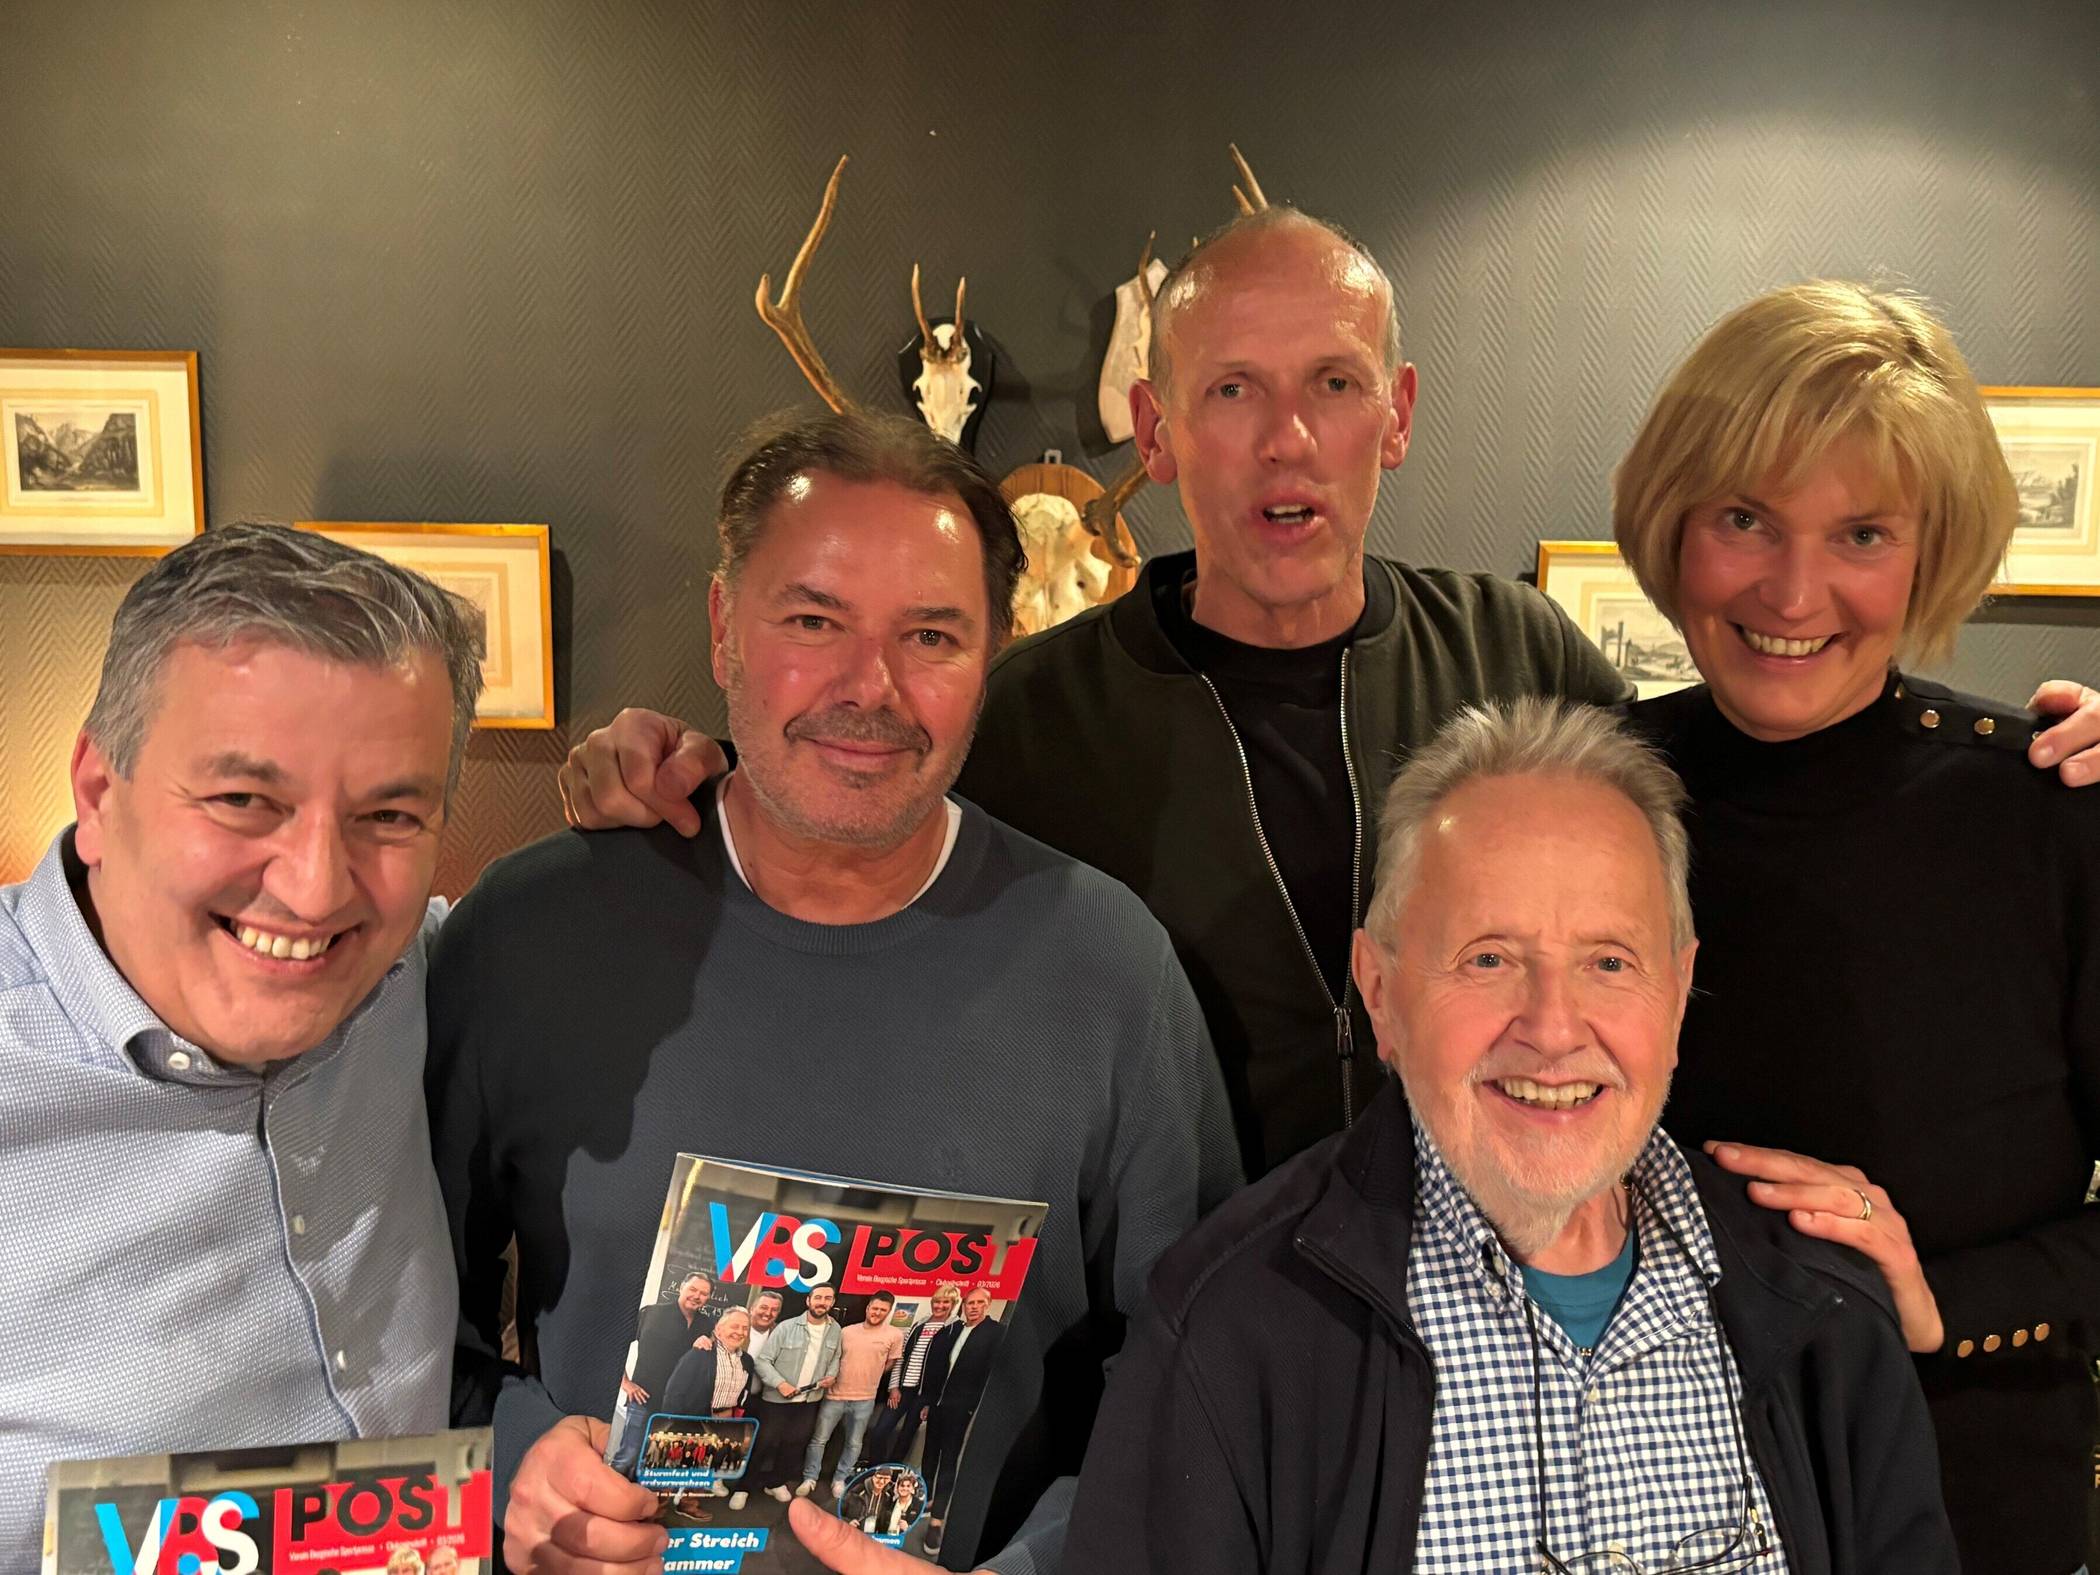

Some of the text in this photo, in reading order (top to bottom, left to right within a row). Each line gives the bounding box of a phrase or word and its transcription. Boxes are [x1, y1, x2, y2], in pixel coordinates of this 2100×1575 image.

[709, 1201, 1020, 1293] VBS POST
[691, 1469, 710, 1478] und
[94, 1473, 471, 1575] VBS POST
[689, 1531, 760, 1549] Streich
[661, 1557, 736, 1572] ammer
